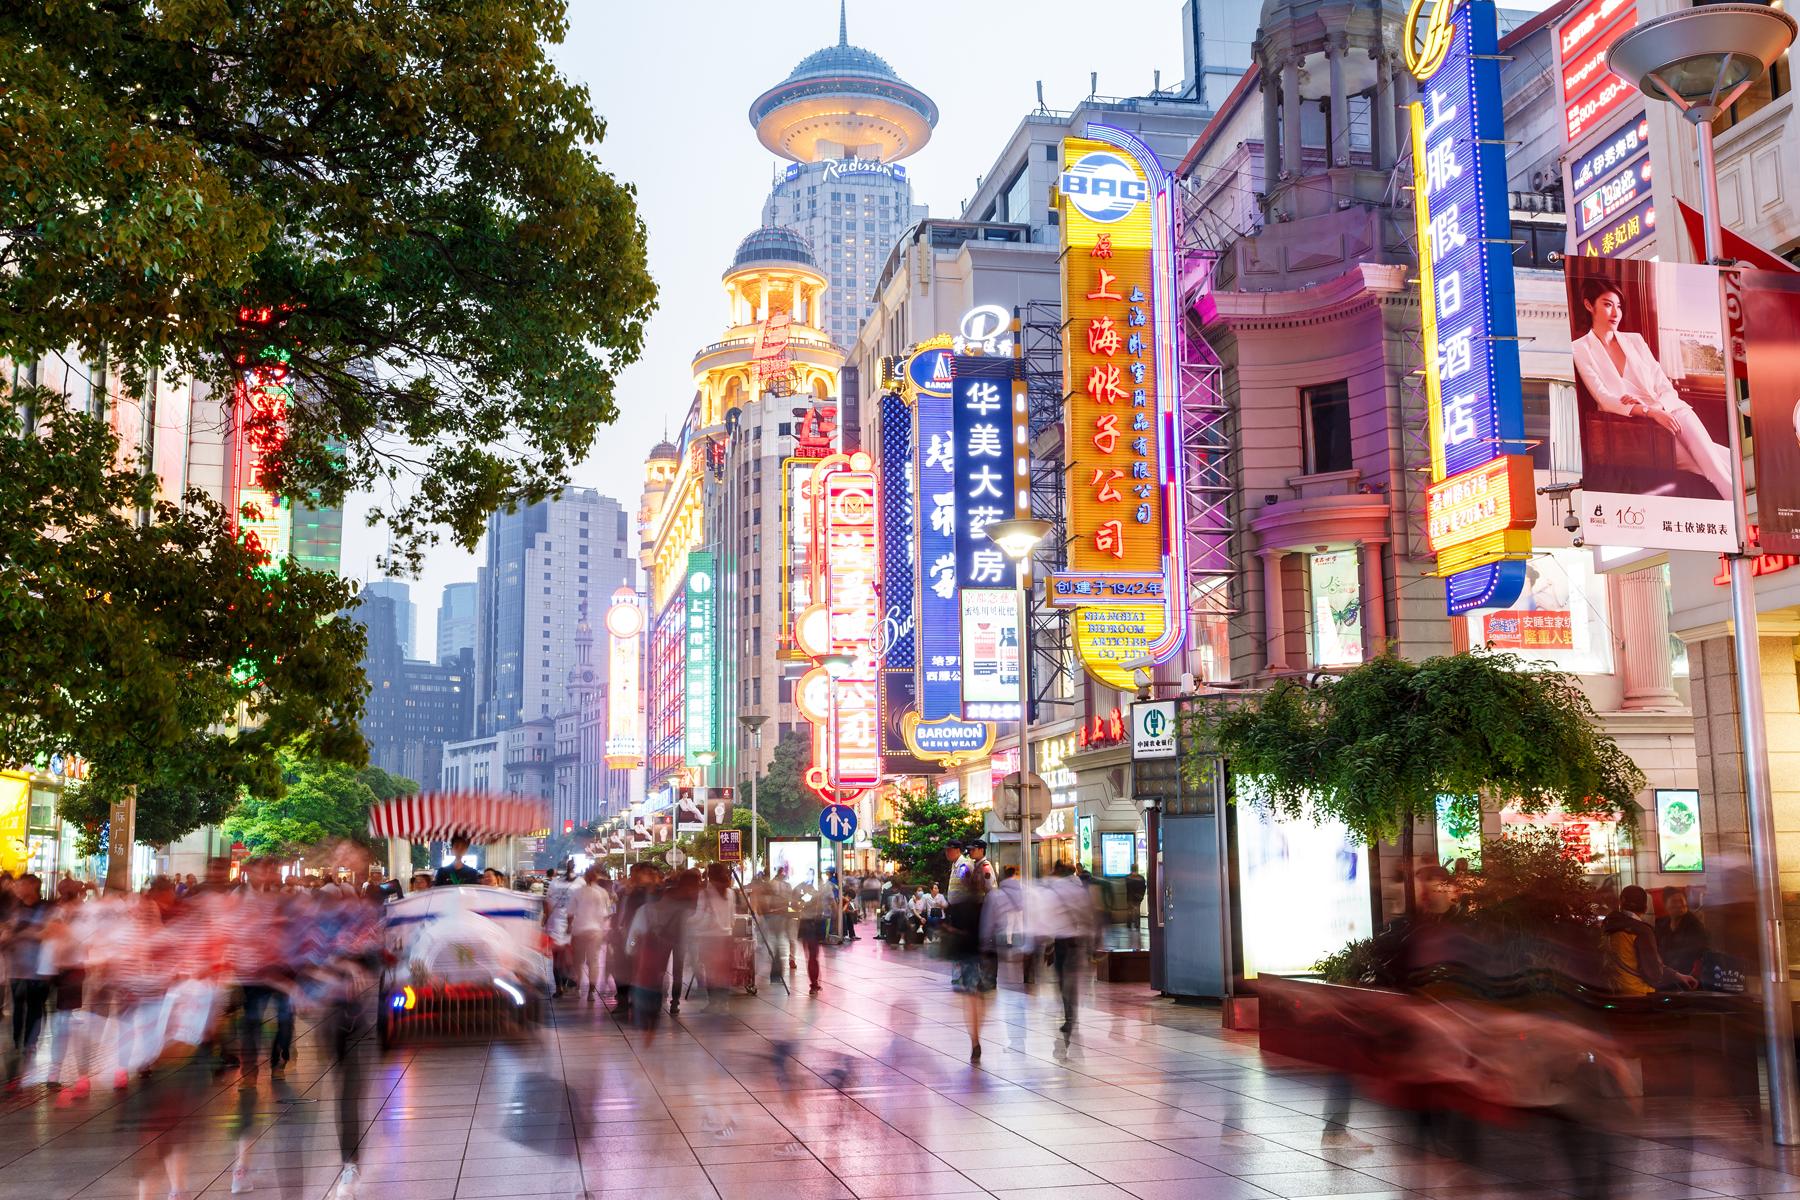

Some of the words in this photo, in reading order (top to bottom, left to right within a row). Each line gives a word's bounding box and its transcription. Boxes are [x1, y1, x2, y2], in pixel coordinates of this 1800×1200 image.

[823, 156, 891, 181] Radisson
[1063, 175, 1147, 201] BAC
[1424, 89, 1482, 445] 上服假日酒店
[966, 382, 1006, 583] 华美大药房
[1662, 520, 1729, 535] 瑞士依波路表
[1055, 580, 1163, 596] 创建于1942年
[1084, 611, 1146, 622] SHANGHAI
[1087, 623, 1146, 634] BEDROOM
[1090, 637, 1148, 647] ARTICLES
[917, 727, 982, 738] BAROMON
[1137, 737, 1174, 748] 中国农业银行
[720, 832, 739, 844] 快照
